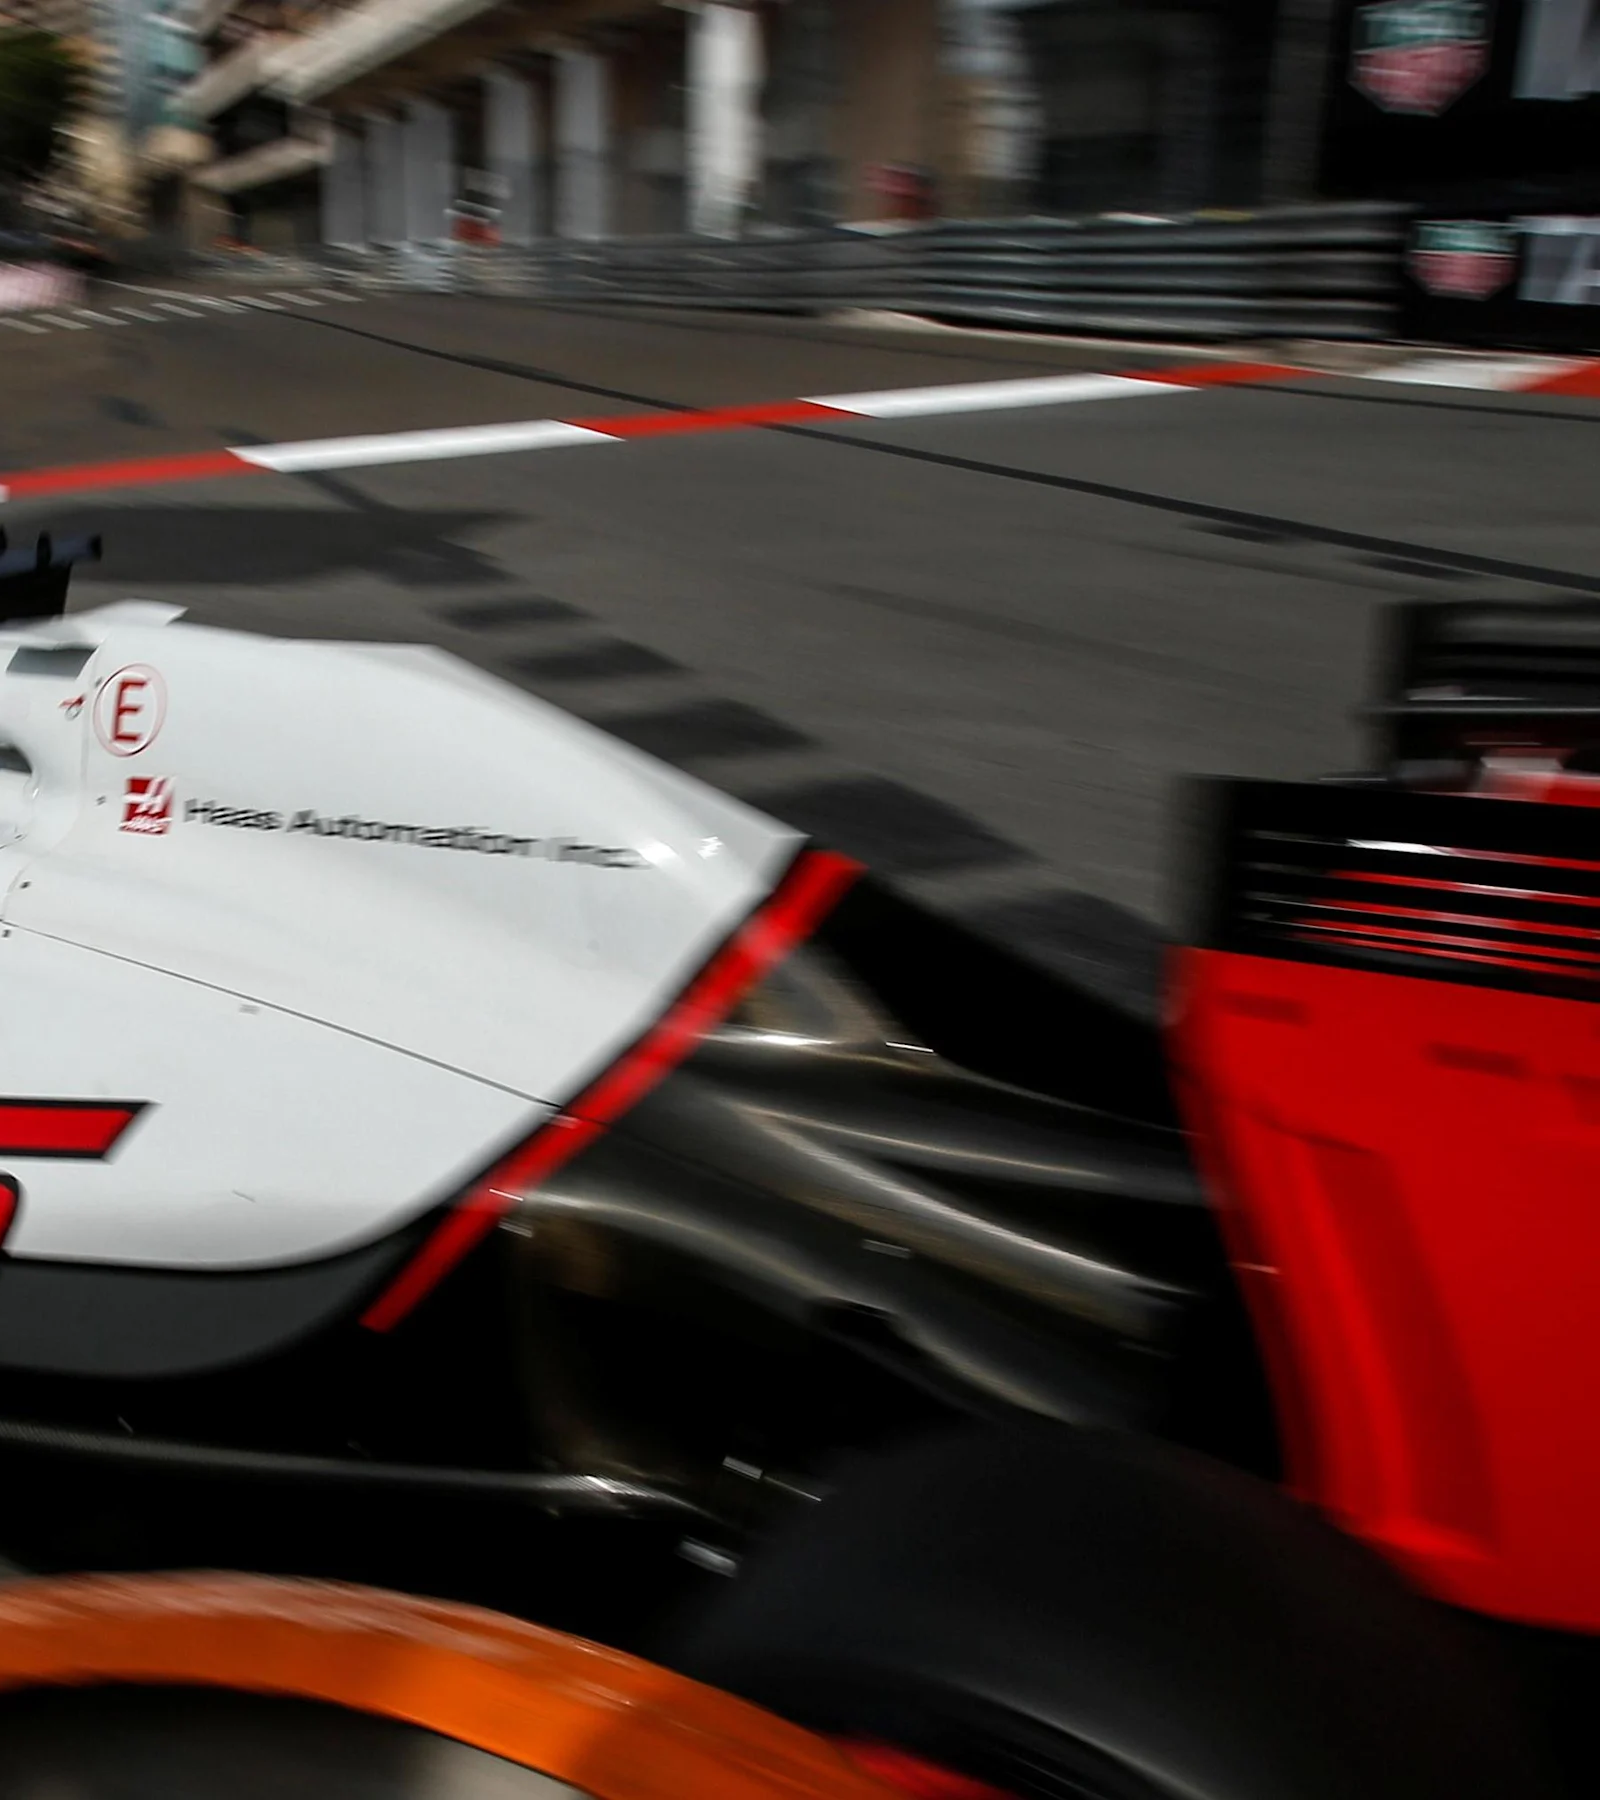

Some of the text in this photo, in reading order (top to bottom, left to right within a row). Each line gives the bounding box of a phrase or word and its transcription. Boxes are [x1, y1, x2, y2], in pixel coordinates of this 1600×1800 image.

[110, 679, 148, 743] E
[183, 797, 283, 832] Haas
[286, 808, 541, 857] Automation
